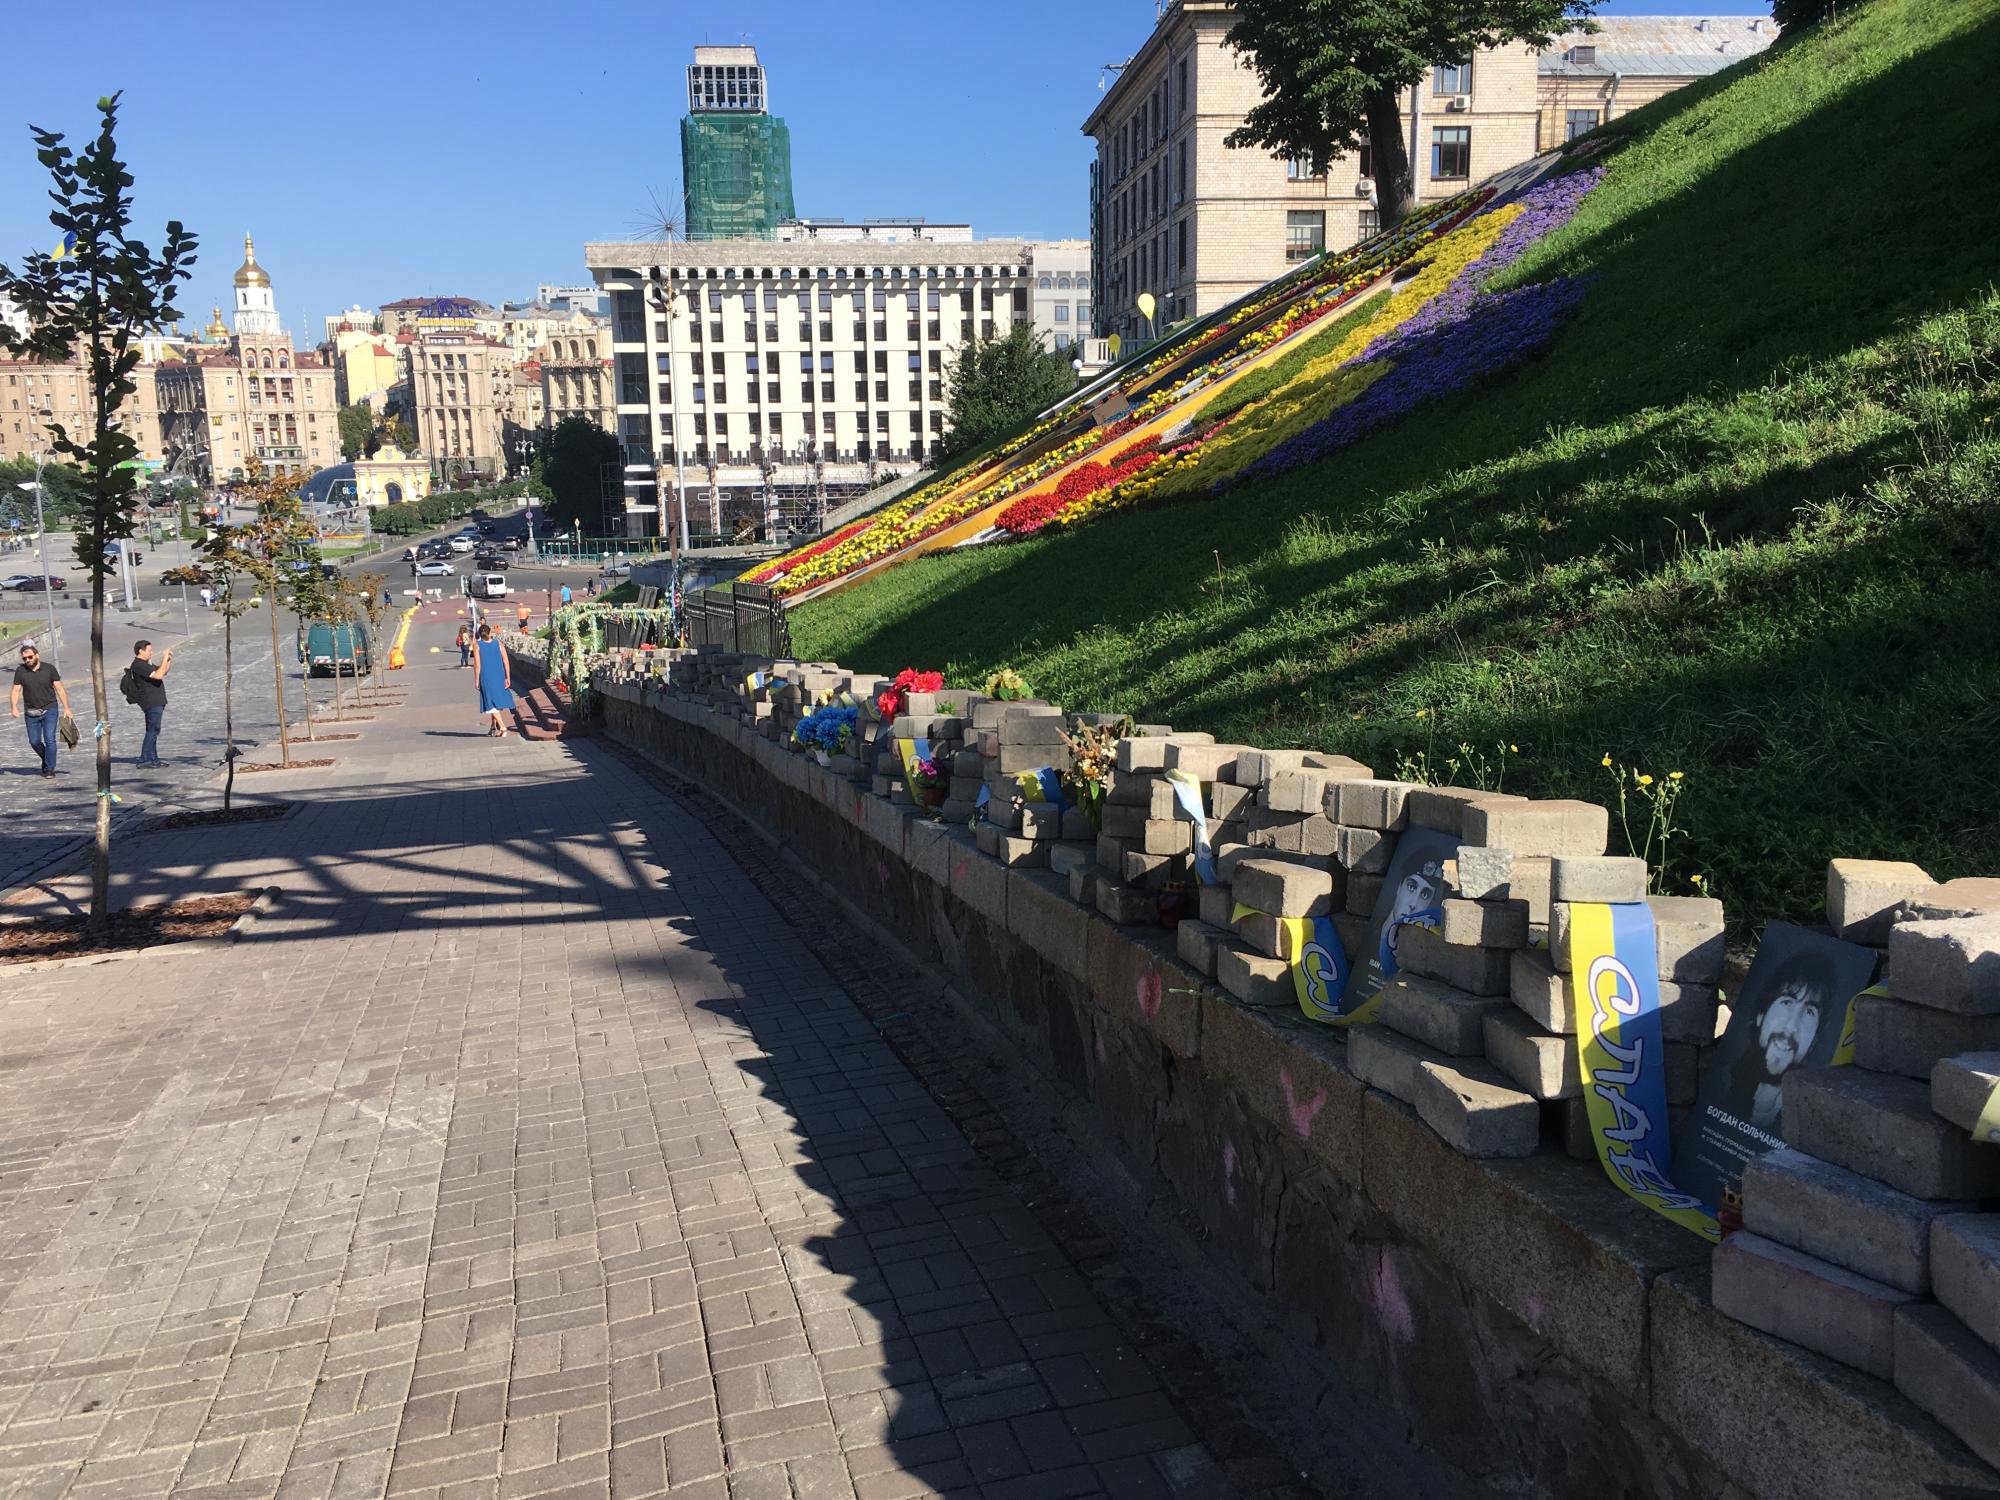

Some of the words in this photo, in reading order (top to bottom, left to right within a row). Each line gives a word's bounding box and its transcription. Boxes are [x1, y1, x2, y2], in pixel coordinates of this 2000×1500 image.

[1588, 955, 1702, 1209] СЛАВА
[1706, 1105, 1738, 1128] БОГДАН
[1738, 1121, 1788, 1150] СОЛЬЧАНИК
